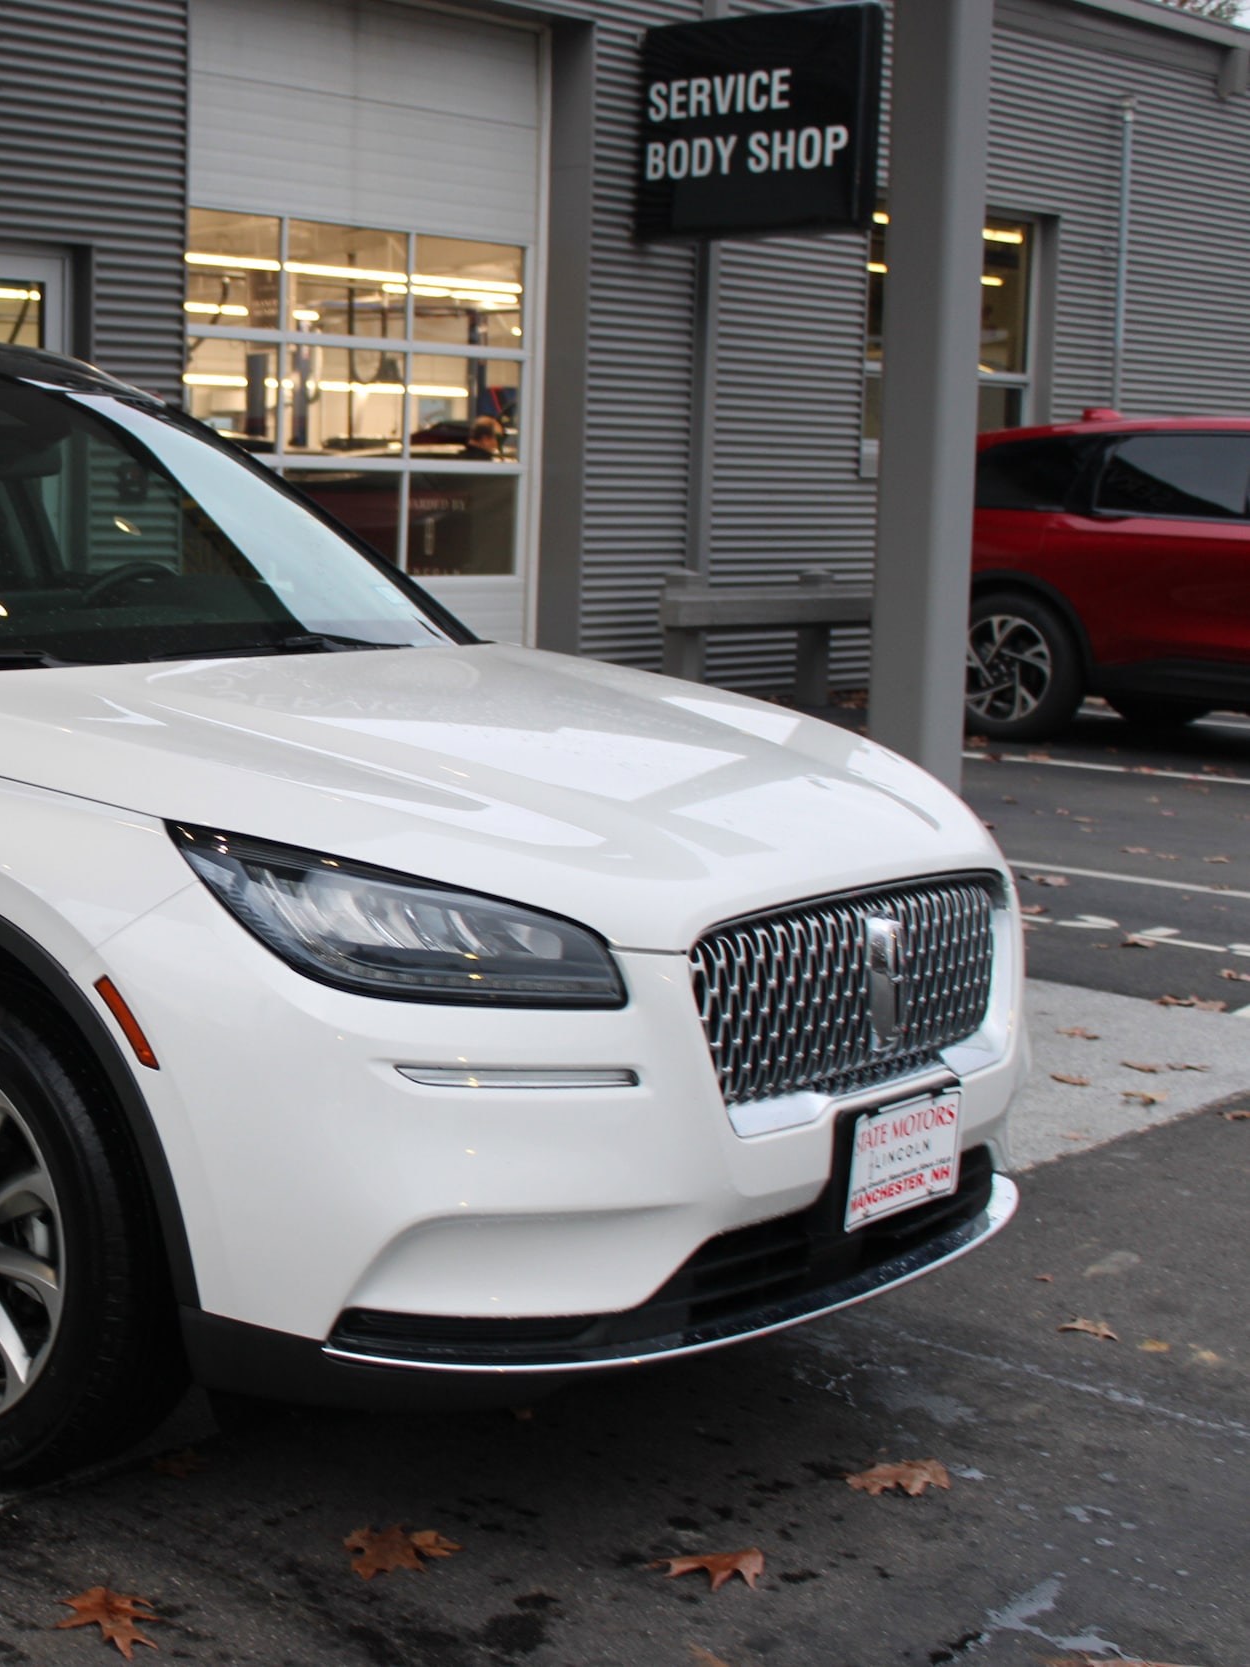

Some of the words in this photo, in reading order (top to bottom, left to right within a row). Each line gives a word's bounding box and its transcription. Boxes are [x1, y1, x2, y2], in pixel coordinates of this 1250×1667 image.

[648, 68, 791, 122] SERVICE
[646, 135, 737, 181] BODY
[747, 125, 848, 173] SHOP
[893, 1104, 956, 1137] MOTORS
[875, 1140, 930, 1168] LINCOLN
[931, 1165, 951, 1183] NH
